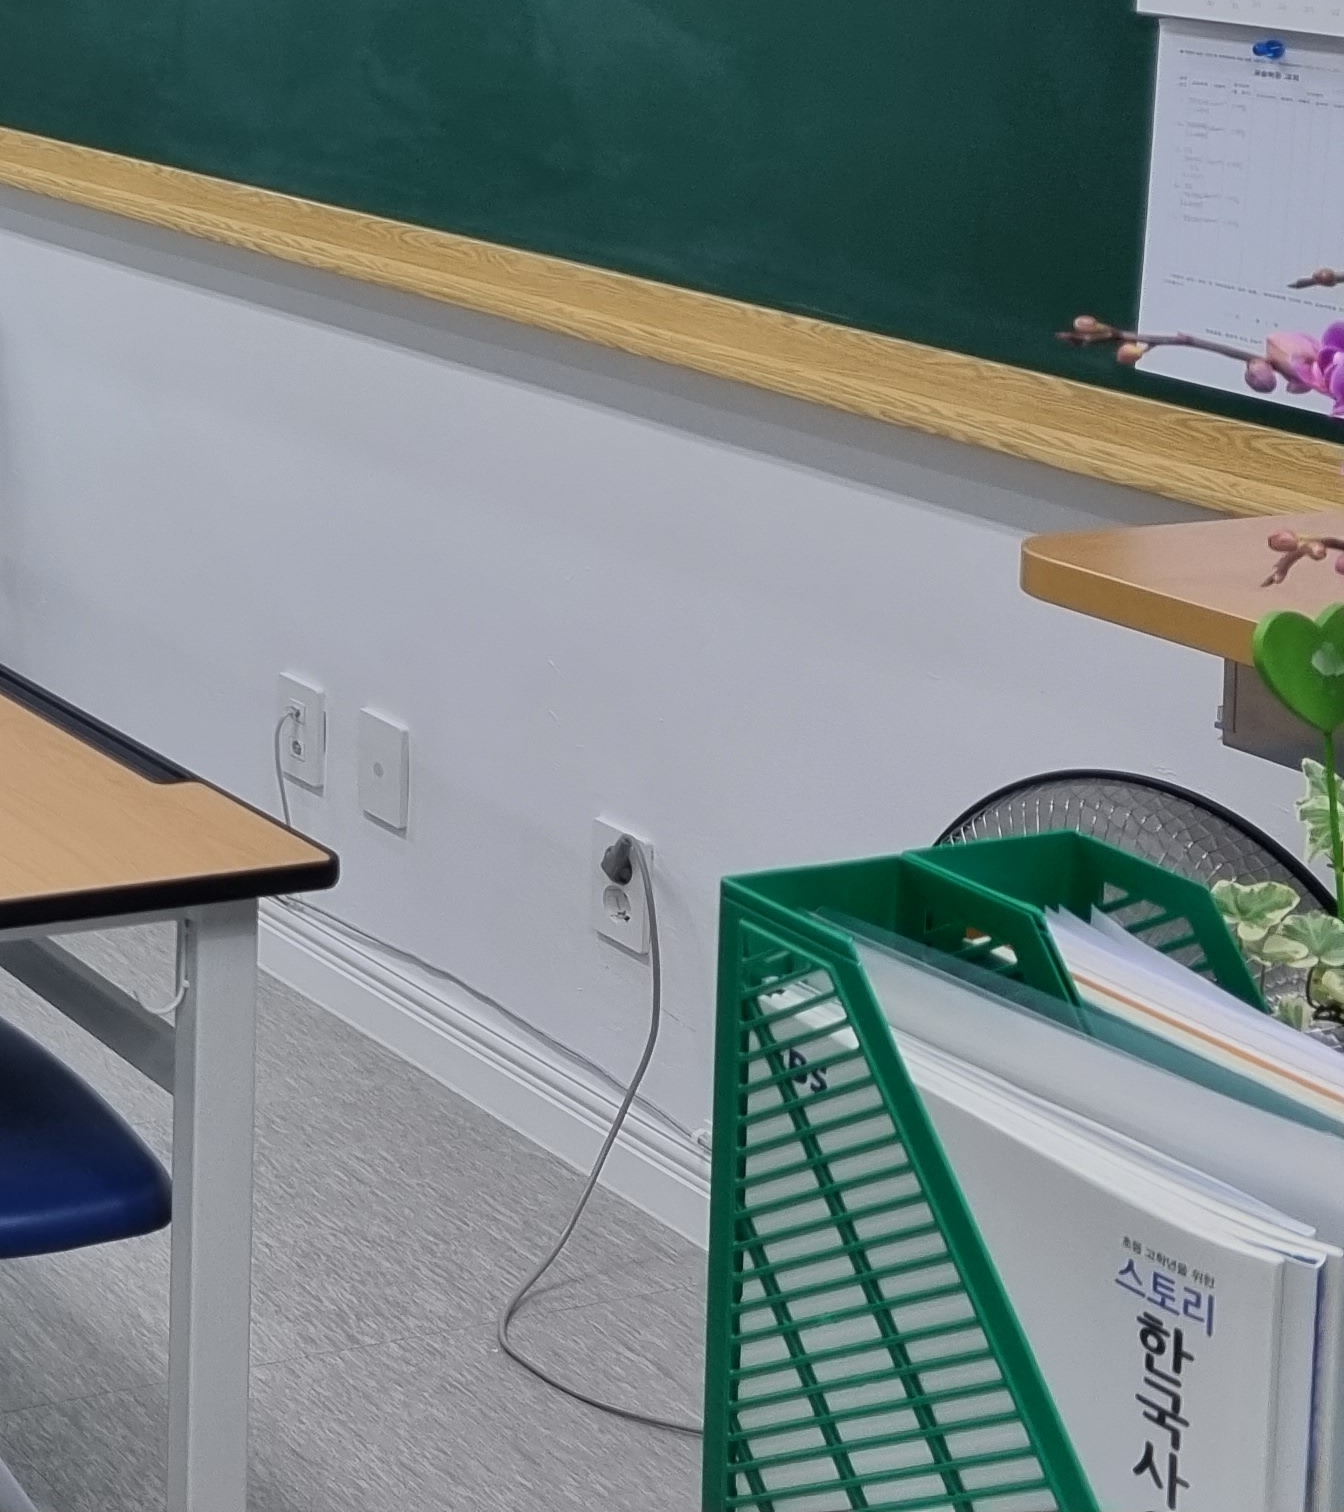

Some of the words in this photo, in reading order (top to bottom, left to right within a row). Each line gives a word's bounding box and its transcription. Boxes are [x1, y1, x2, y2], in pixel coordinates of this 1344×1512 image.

[1114, 1258, 1214, 1337] 스토리
[1145, 1247, 1188, 1277] 고학년을
[1192, 1268, 1215, 1289] 위한
[1132, 1311, 1195, 1511] 한국사
